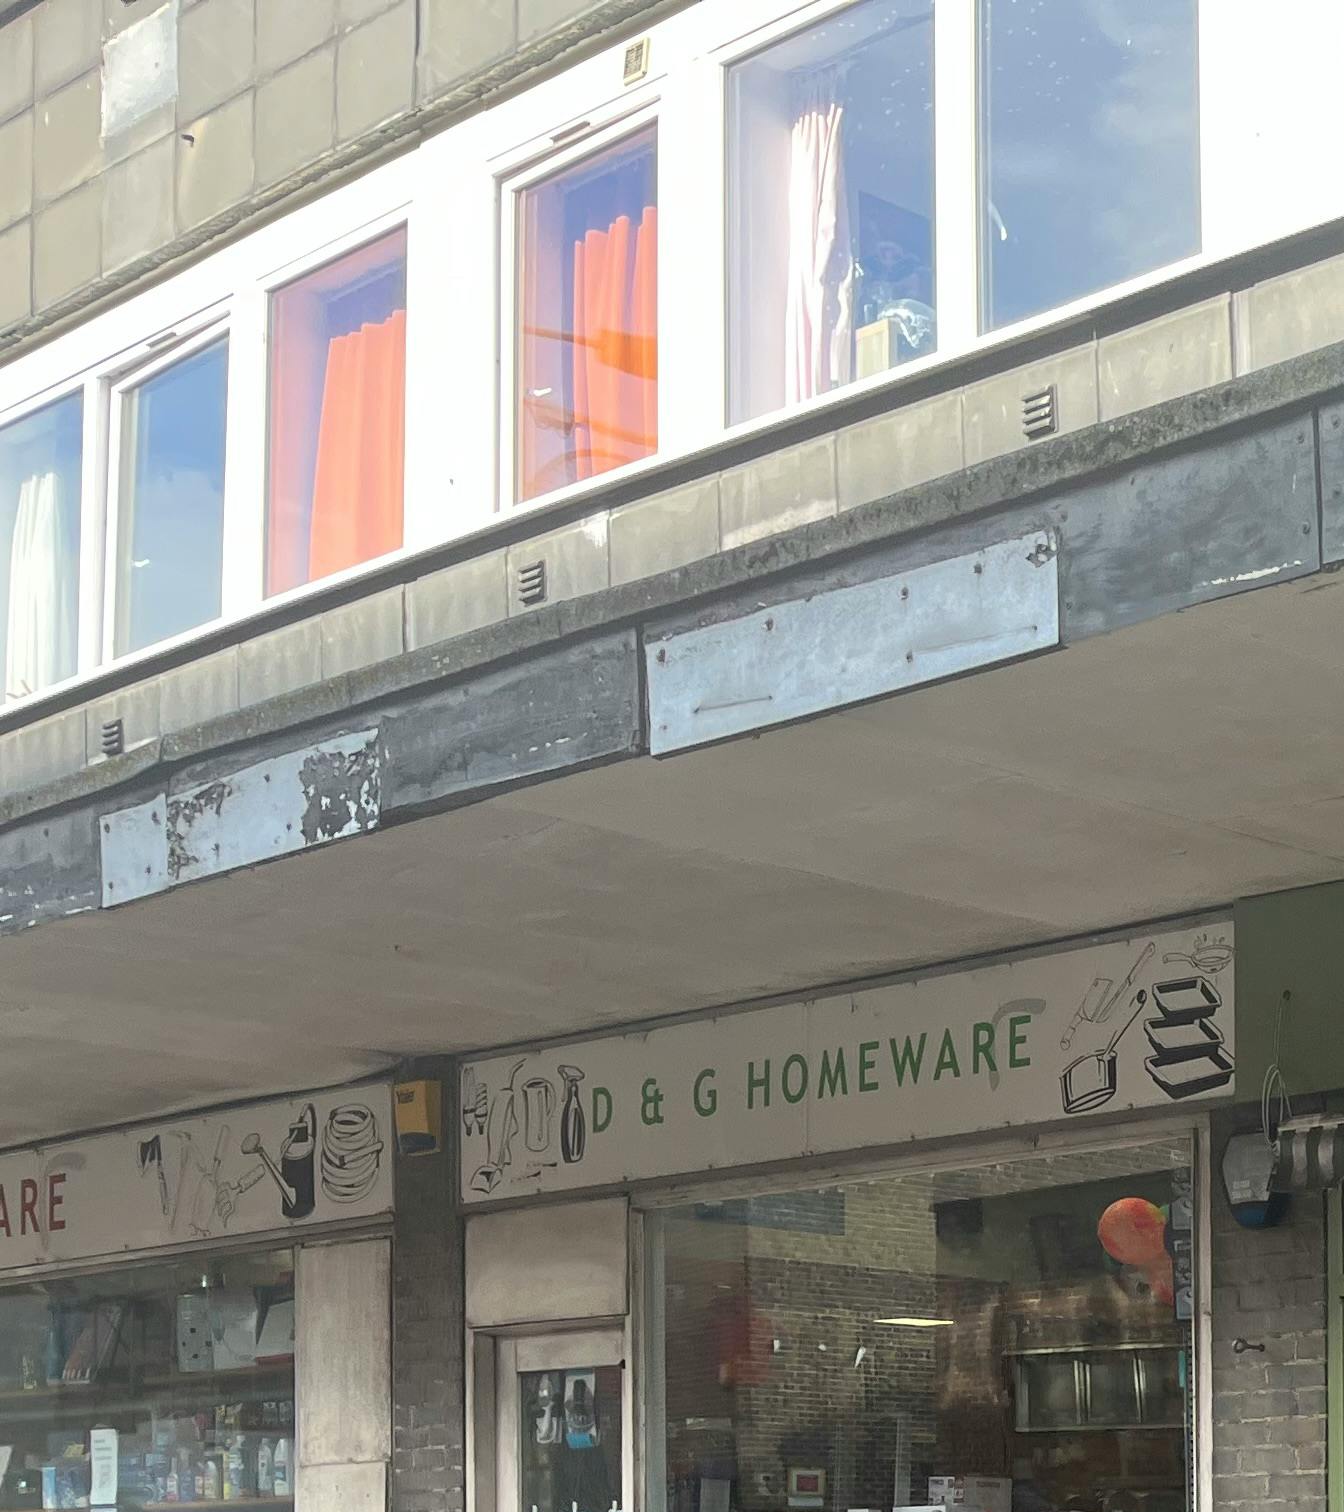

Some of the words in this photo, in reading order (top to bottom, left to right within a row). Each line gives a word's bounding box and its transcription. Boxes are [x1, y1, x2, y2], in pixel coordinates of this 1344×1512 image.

[592, 1086, 614, 1133] D
[640, 1077, 665, 1126] &
[693, 1068, 718, 1117] G
[746, 1014, 1033, 1110] HOMEWARE
